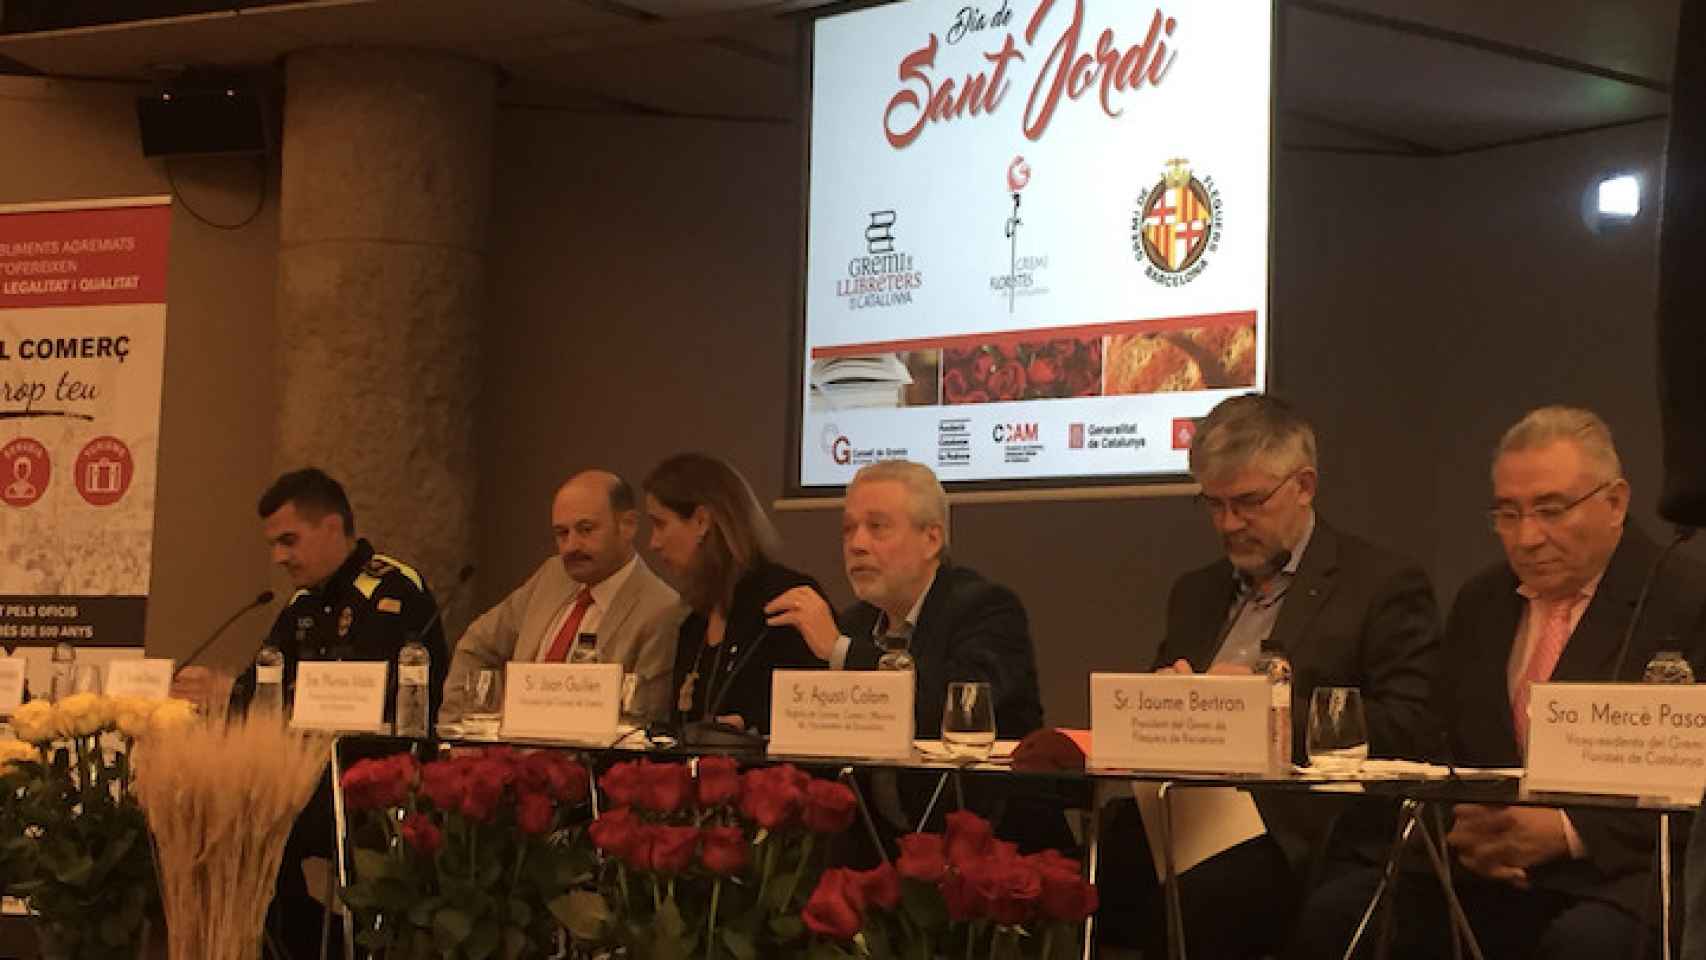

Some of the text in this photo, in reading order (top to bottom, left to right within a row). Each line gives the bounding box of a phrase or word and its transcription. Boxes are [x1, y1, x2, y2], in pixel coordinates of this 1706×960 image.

[990, 3, 1013, 28] de
[884, 0, 1179, 149] Sant Jordi
[1144, 258, 1208, 287] BARCELONA
[4, 279, 70, 295] LEGALITAT
[18, 336, 130, 363] COMERÇ
[56, 370, 98, 402] teu
[1138, 691, 1184, 712] Jaume
[1189, 691, 1246, 712] Bertran
